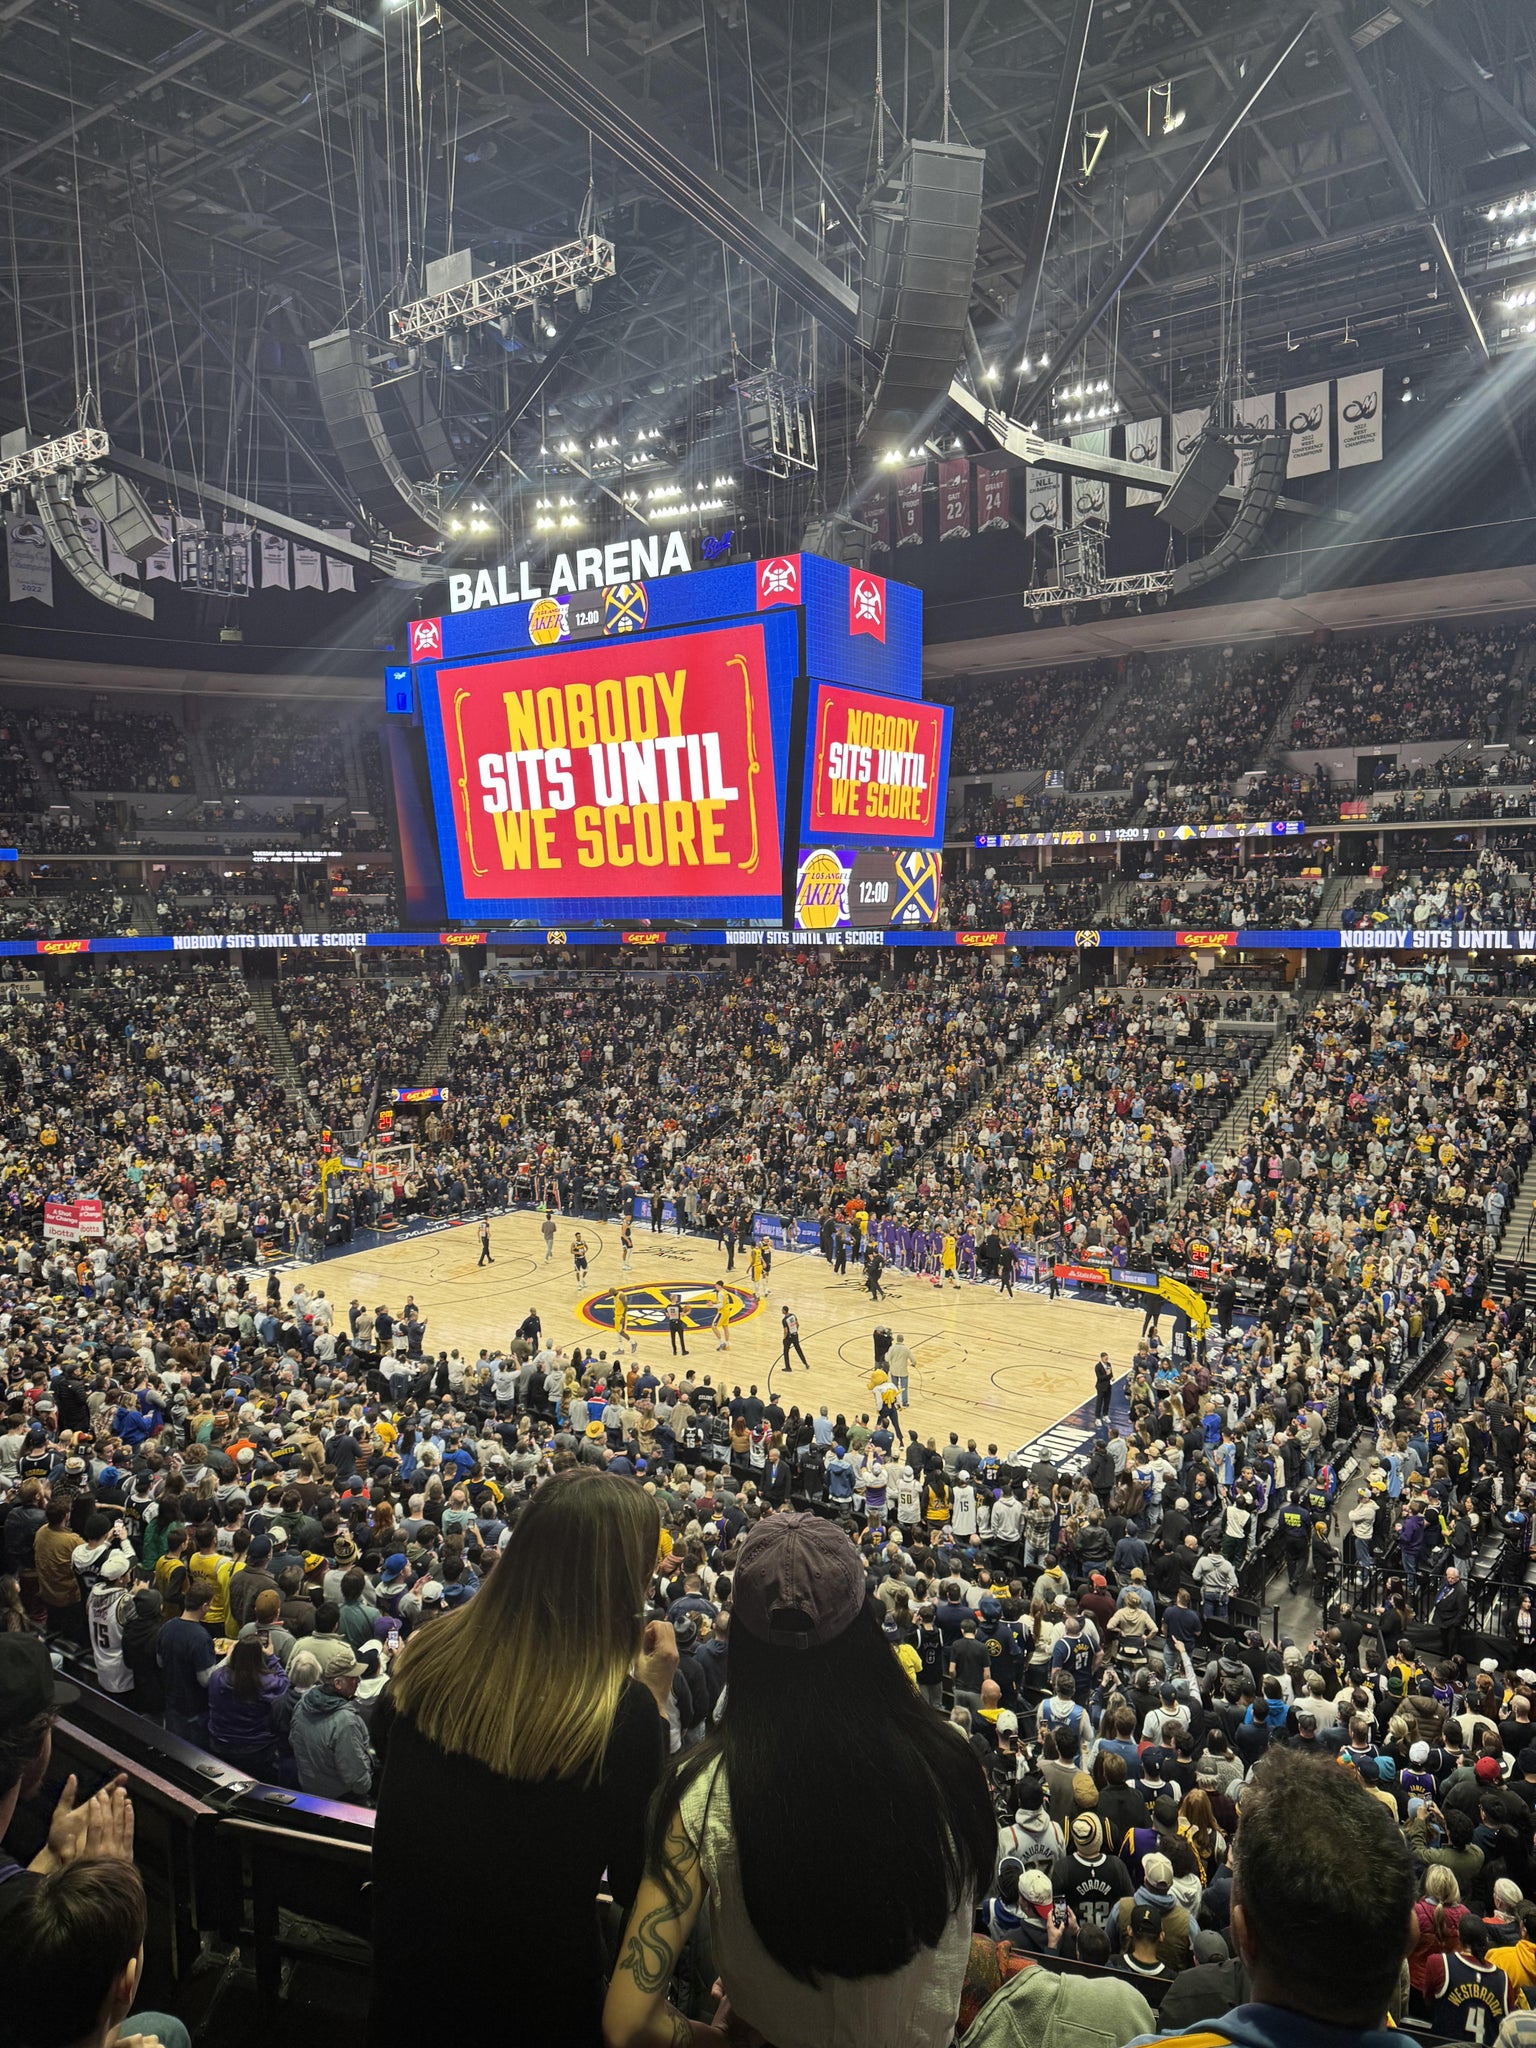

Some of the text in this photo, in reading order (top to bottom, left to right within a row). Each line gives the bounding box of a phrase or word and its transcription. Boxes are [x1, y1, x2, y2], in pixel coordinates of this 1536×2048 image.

[1344, 432, 1376, 443] CONFERENCE
[1345, 438, 1375, 448] CHAMPIONS
[1292, 443, 1324, 454] CONFERENCE
[1293, 449, 1322, 459] CHAMPIONS
[1036, 478, 1053, 487] NLL
[986, 493, 1001, 510] 24
[947, 502, 964, 520] 22
[907, 511, 914, 526] 9
[449, 530, 692, 613] BALL ARENA
[22, 584, 42, 592] 2022
[576, 610, 600, 626] 12:00
[502, 669, 687, 753] NOBODY
[846, 708, 920, 754] NOBODY
[828, 742, 928, 790] SITS UNTIL
[478, 732, 739, 814] SITS UNTIL
[831, 778, 923, 821] WE SCORE
[492, 798, 731, 871] WE SCORE
[1089, 832, 1096, 842] 0
[1114, 828, 1140, 838] 12:00
[1158, 830, 1165, 839] 0
[859, 881, 889, 904] 12:00
[172, 933, 366, 950] NOBODY SITS UNTIL WE SCORE!
[446, 934, 480, 942] GET UP!
[628, 934, 644, 942] GET
[726, 932, 884, 944] NOBODY SITS UNTIL WE SCORE!
[962, 934, 998, 943] GET UP!
[1184, 934, 1228, 944] GET UP!
[1340, 930, 1408, 948] NOBODY
[1412, 930, 1452, 948] SITS
[1458, 930, 1512, 948] UNTIL
[44, 942, 81, 951] GET UP!
[378, 1117, 392, 1130] 24
[55, 1216, 78, 1224] Change
[48, 1226, 74, 1238] ibotta
[654, 1252, 693, 1262] Arena
[1192, 1251, 1206, 1262] 24
[686, 1438, 696, 1448] 15
[986, 1470, 998, 1480] 27
[900, 1494, 912, 1505] 50
[960, 1501, 969, 1512] 15
[94, 1622, 110, 1650] 15
[1075, 1651, 1089, 1670] 27
[1410, 1784, 1426, 1794] JAMES
[1022, 1843, 1054, 1862] MURRAY
[1076, 1879, 1112, 1896] GORDON
[1078, 1902, 1110, 1930] 32
[1448, 1983, 1503, 2017] WESTBROOK
[1464, 2007, 1486, 2044] 4
